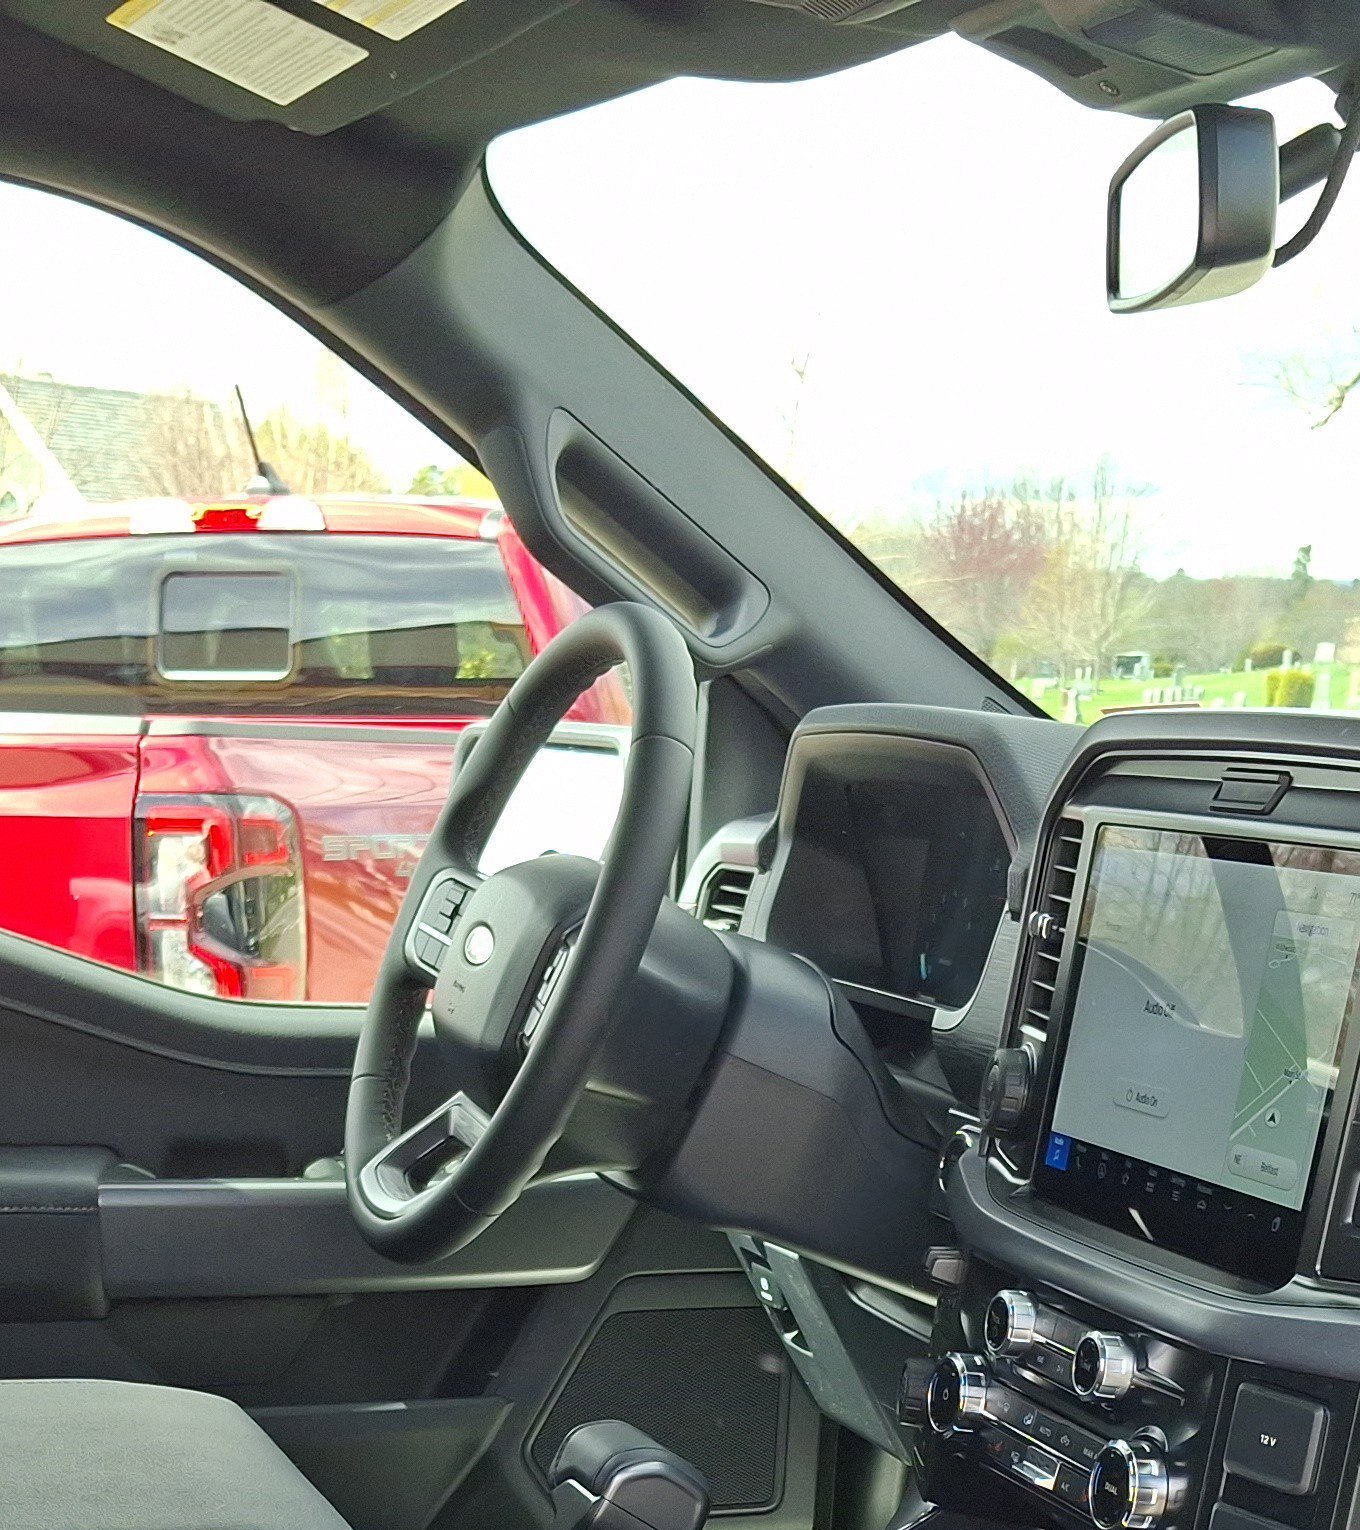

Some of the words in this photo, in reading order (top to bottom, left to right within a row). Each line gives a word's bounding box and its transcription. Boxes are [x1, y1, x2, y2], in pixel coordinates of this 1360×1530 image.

[323, 834, 430, 861] SPOR
[1260, 1433, 1270, 1444] 12
[1270, 1437, 1277, 1447] V
[1105, 1482, 1118, 1495] DUAL
